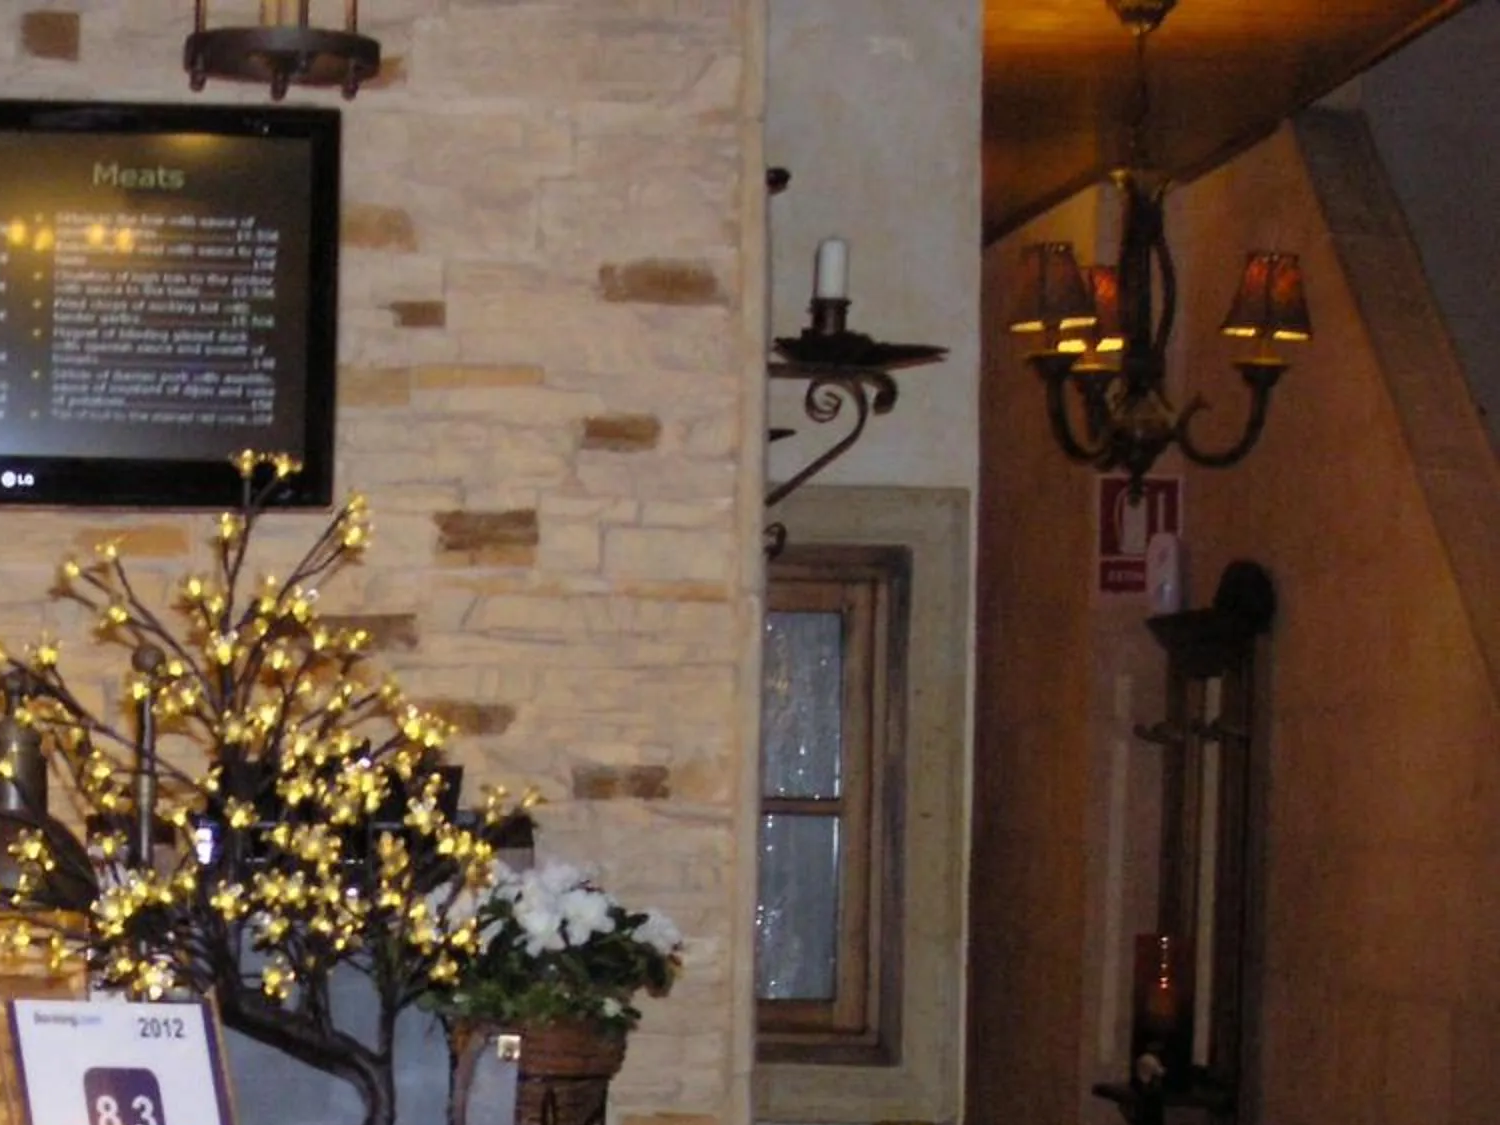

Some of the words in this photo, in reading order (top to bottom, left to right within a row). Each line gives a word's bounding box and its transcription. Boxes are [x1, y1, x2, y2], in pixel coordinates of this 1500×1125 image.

[93, 162, 185, 189] Meats
[17, 472, 35, 486] LG
[137, 1017, 185, 1039] 2012
